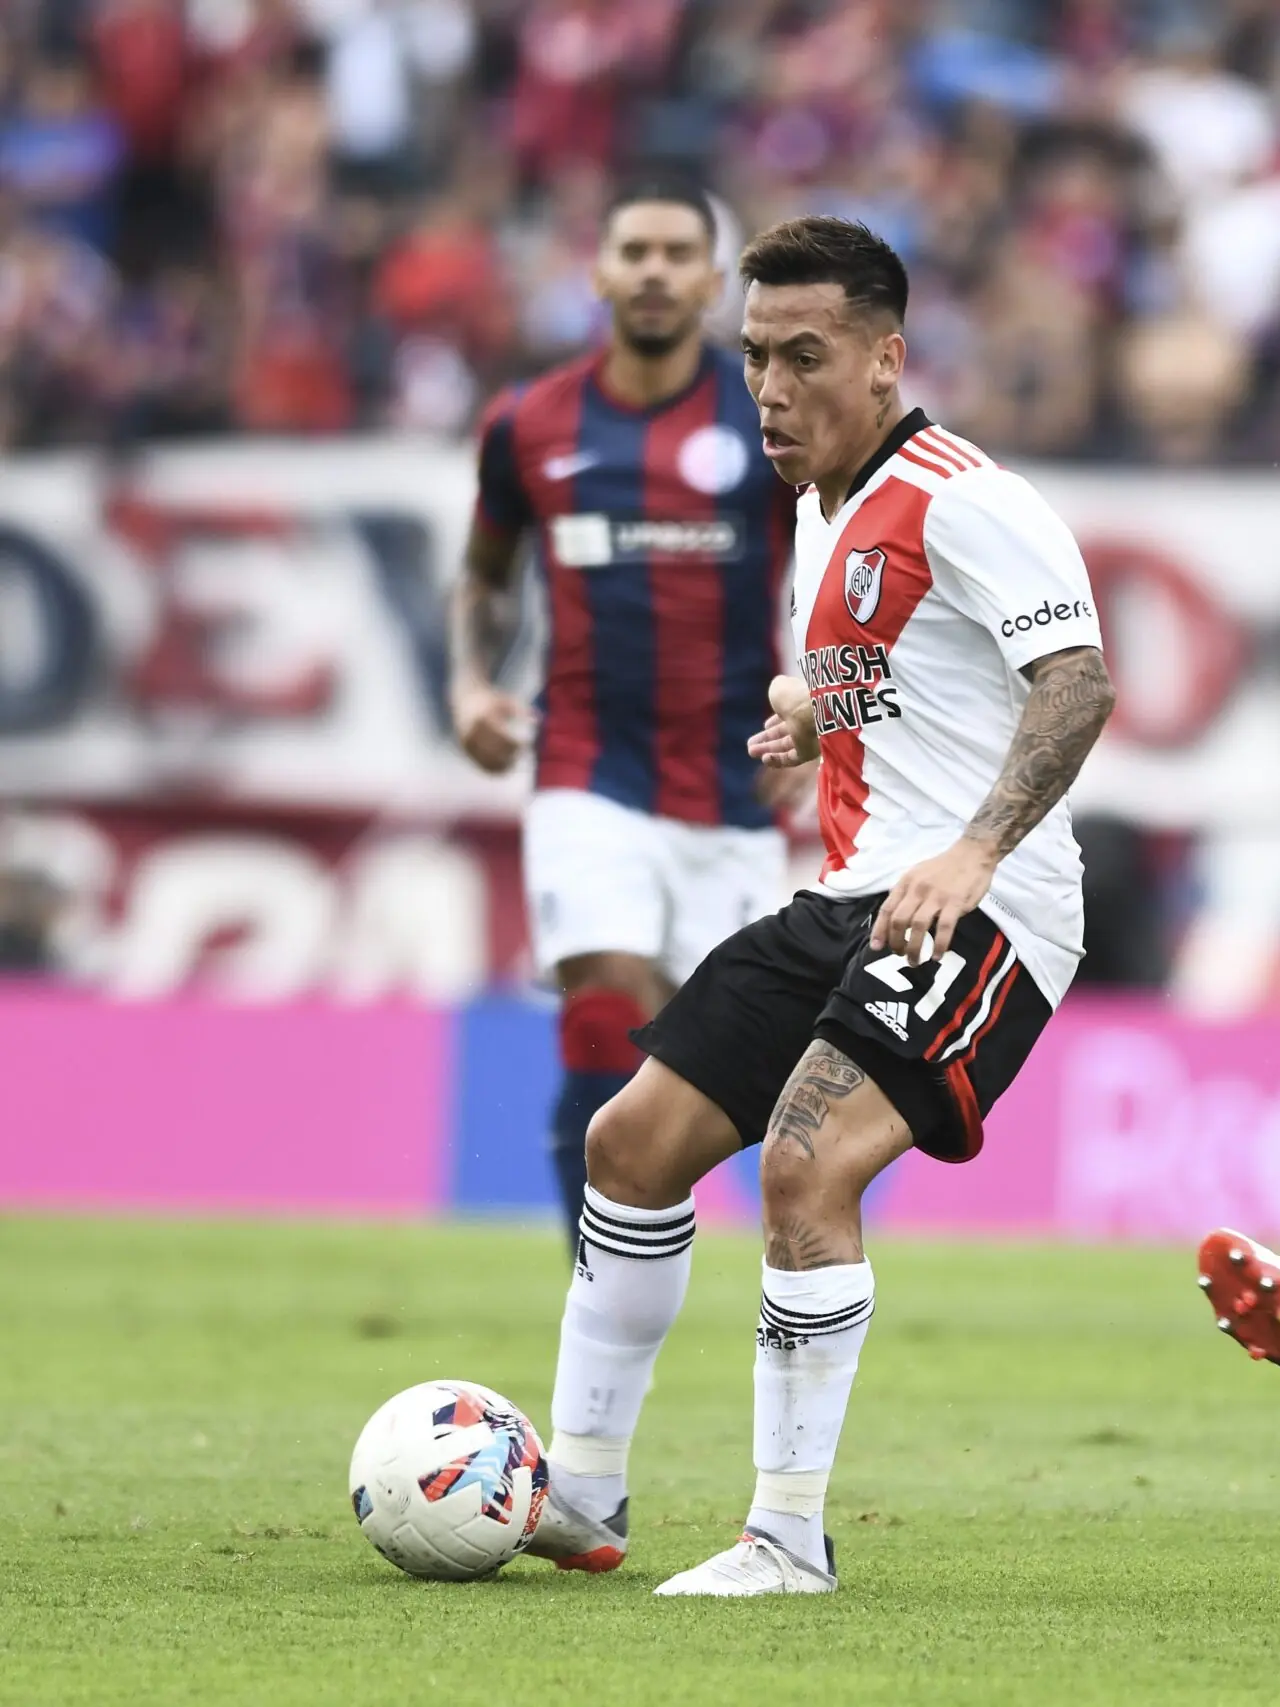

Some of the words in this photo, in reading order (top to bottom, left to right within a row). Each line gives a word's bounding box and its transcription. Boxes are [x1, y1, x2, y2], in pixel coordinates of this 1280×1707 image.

[798, 644, 892, 690] URKISH
[864, 928, 966, 1021] 21
[864, 1001, 909, 1041] adidas
